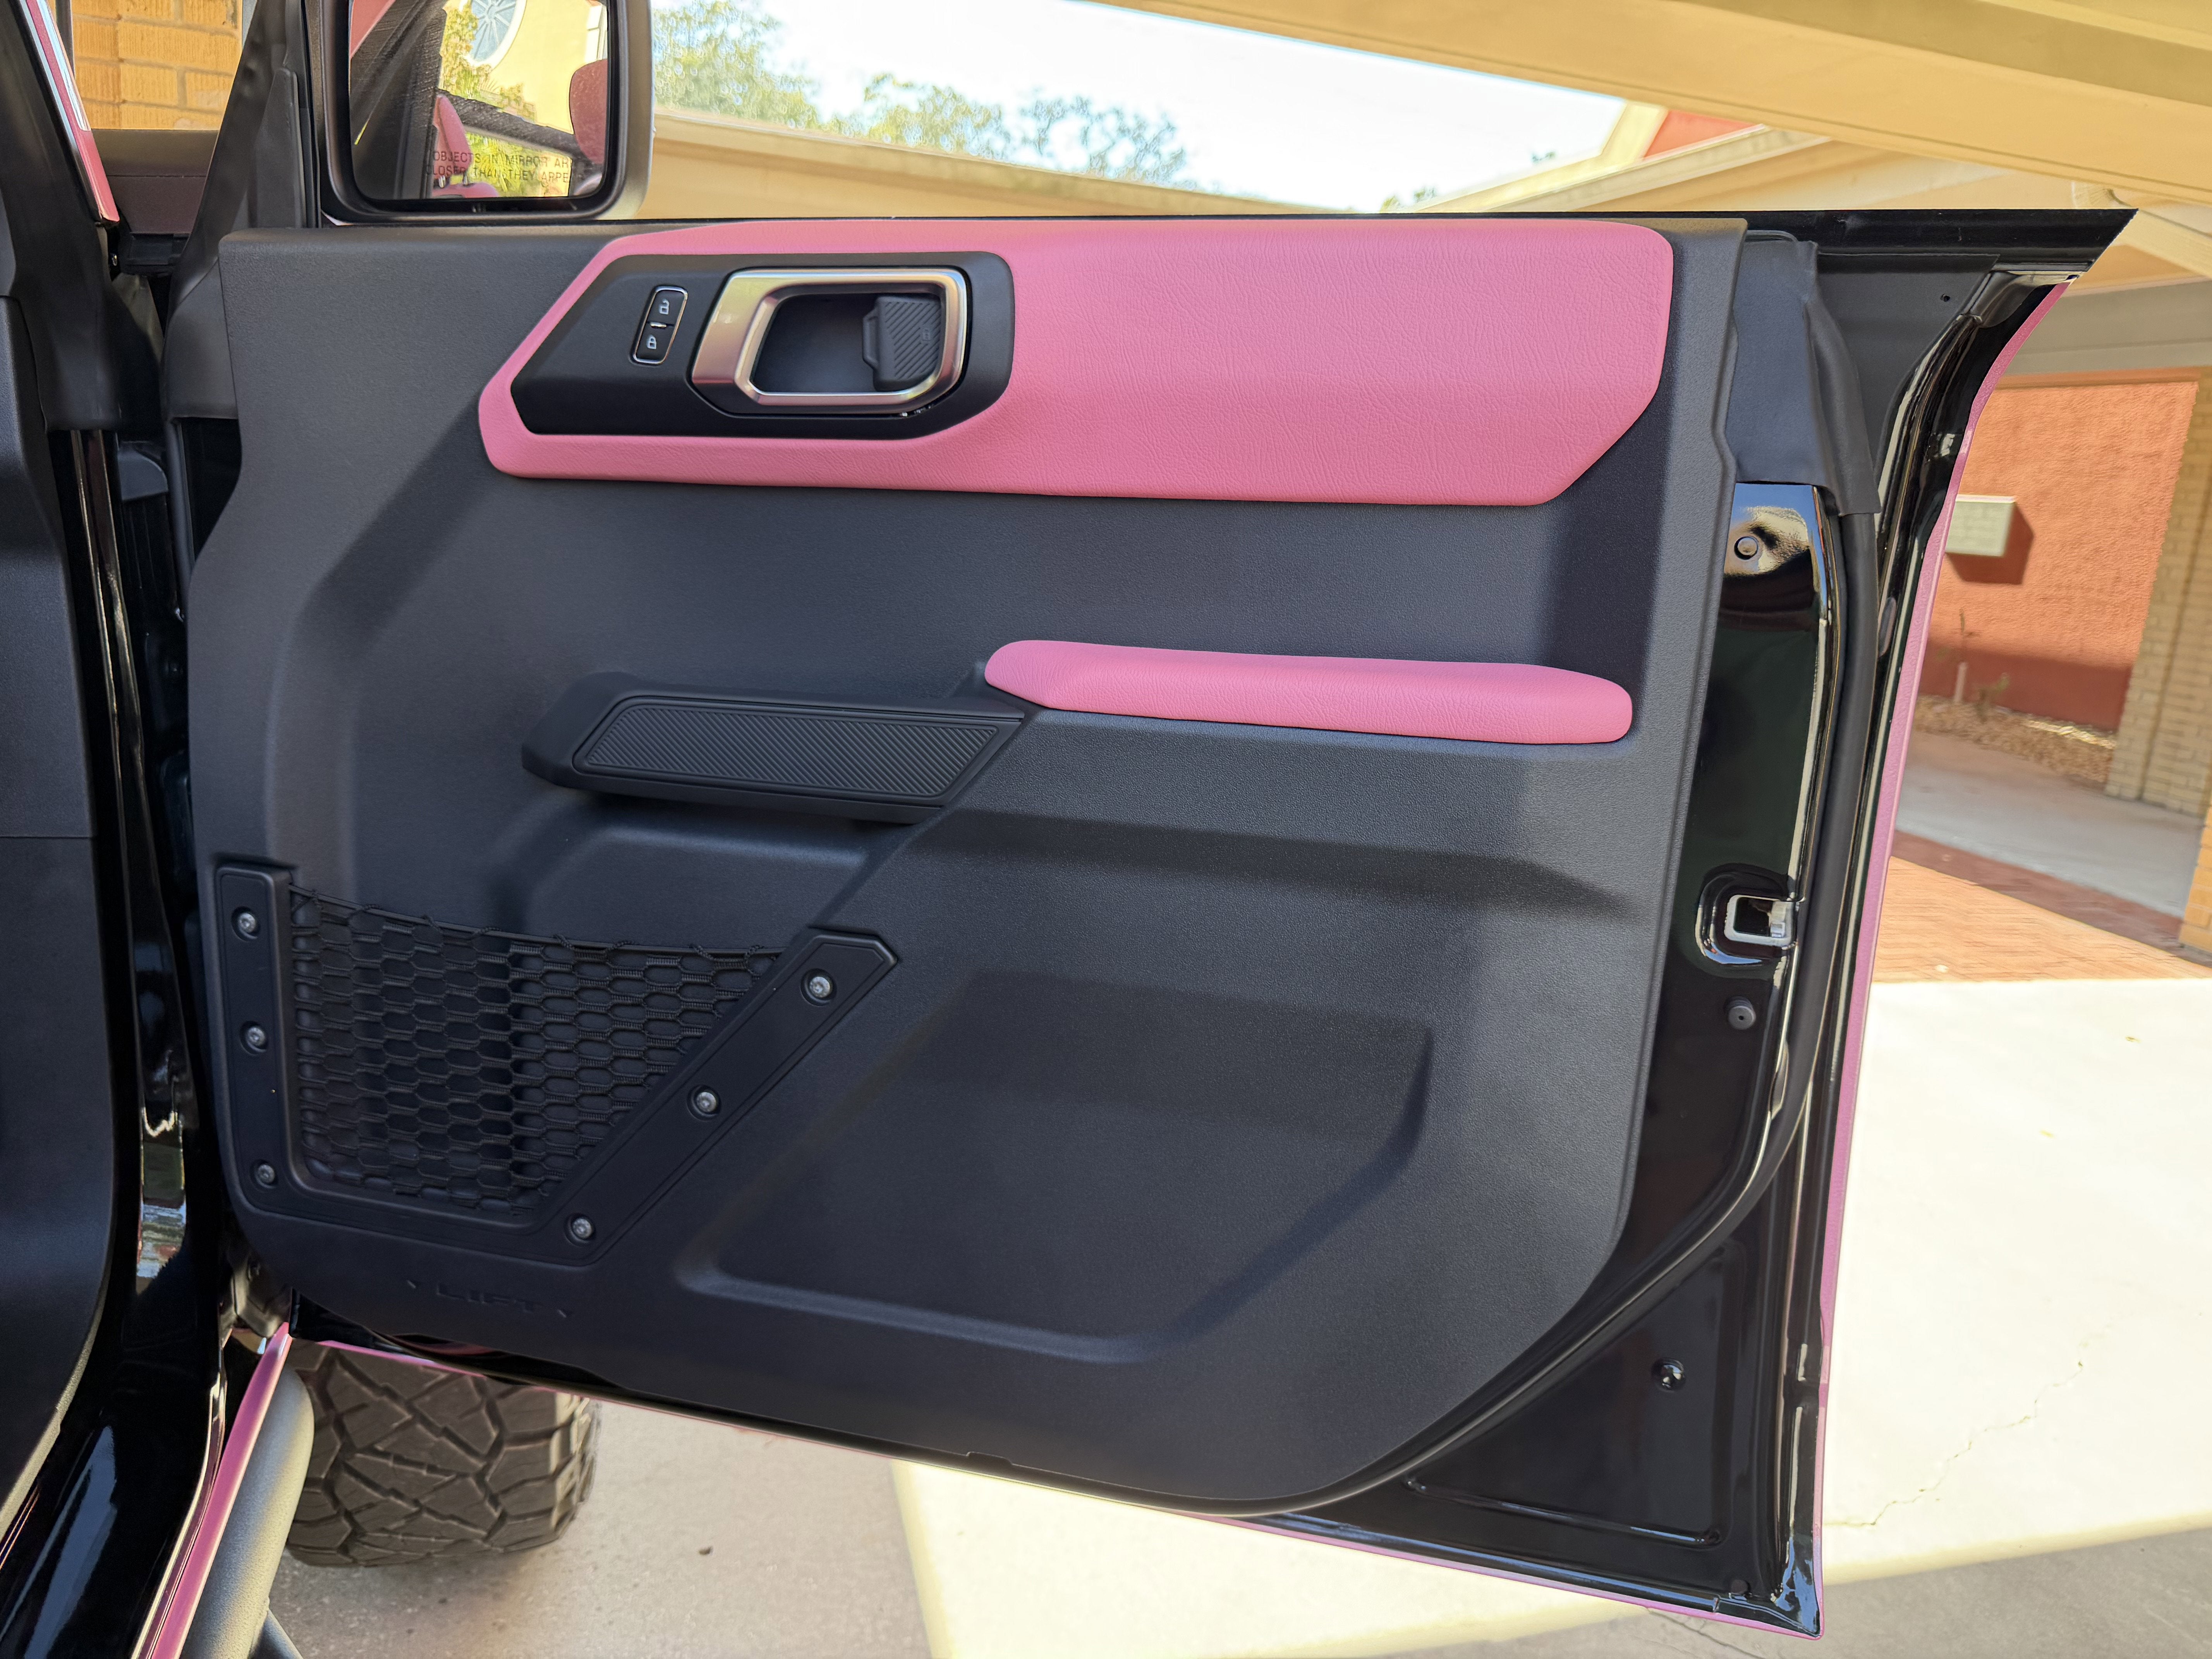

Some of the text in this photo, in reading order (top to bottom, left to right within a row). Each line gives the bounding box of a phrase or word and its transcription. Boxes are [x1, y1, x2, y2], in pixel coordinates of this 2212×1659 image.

[433, 151, 573, 168] OBJECTS IN MIRROR AR
[473, 167, 501, 178] THAN
[508, 169, 536, 180] THEY
